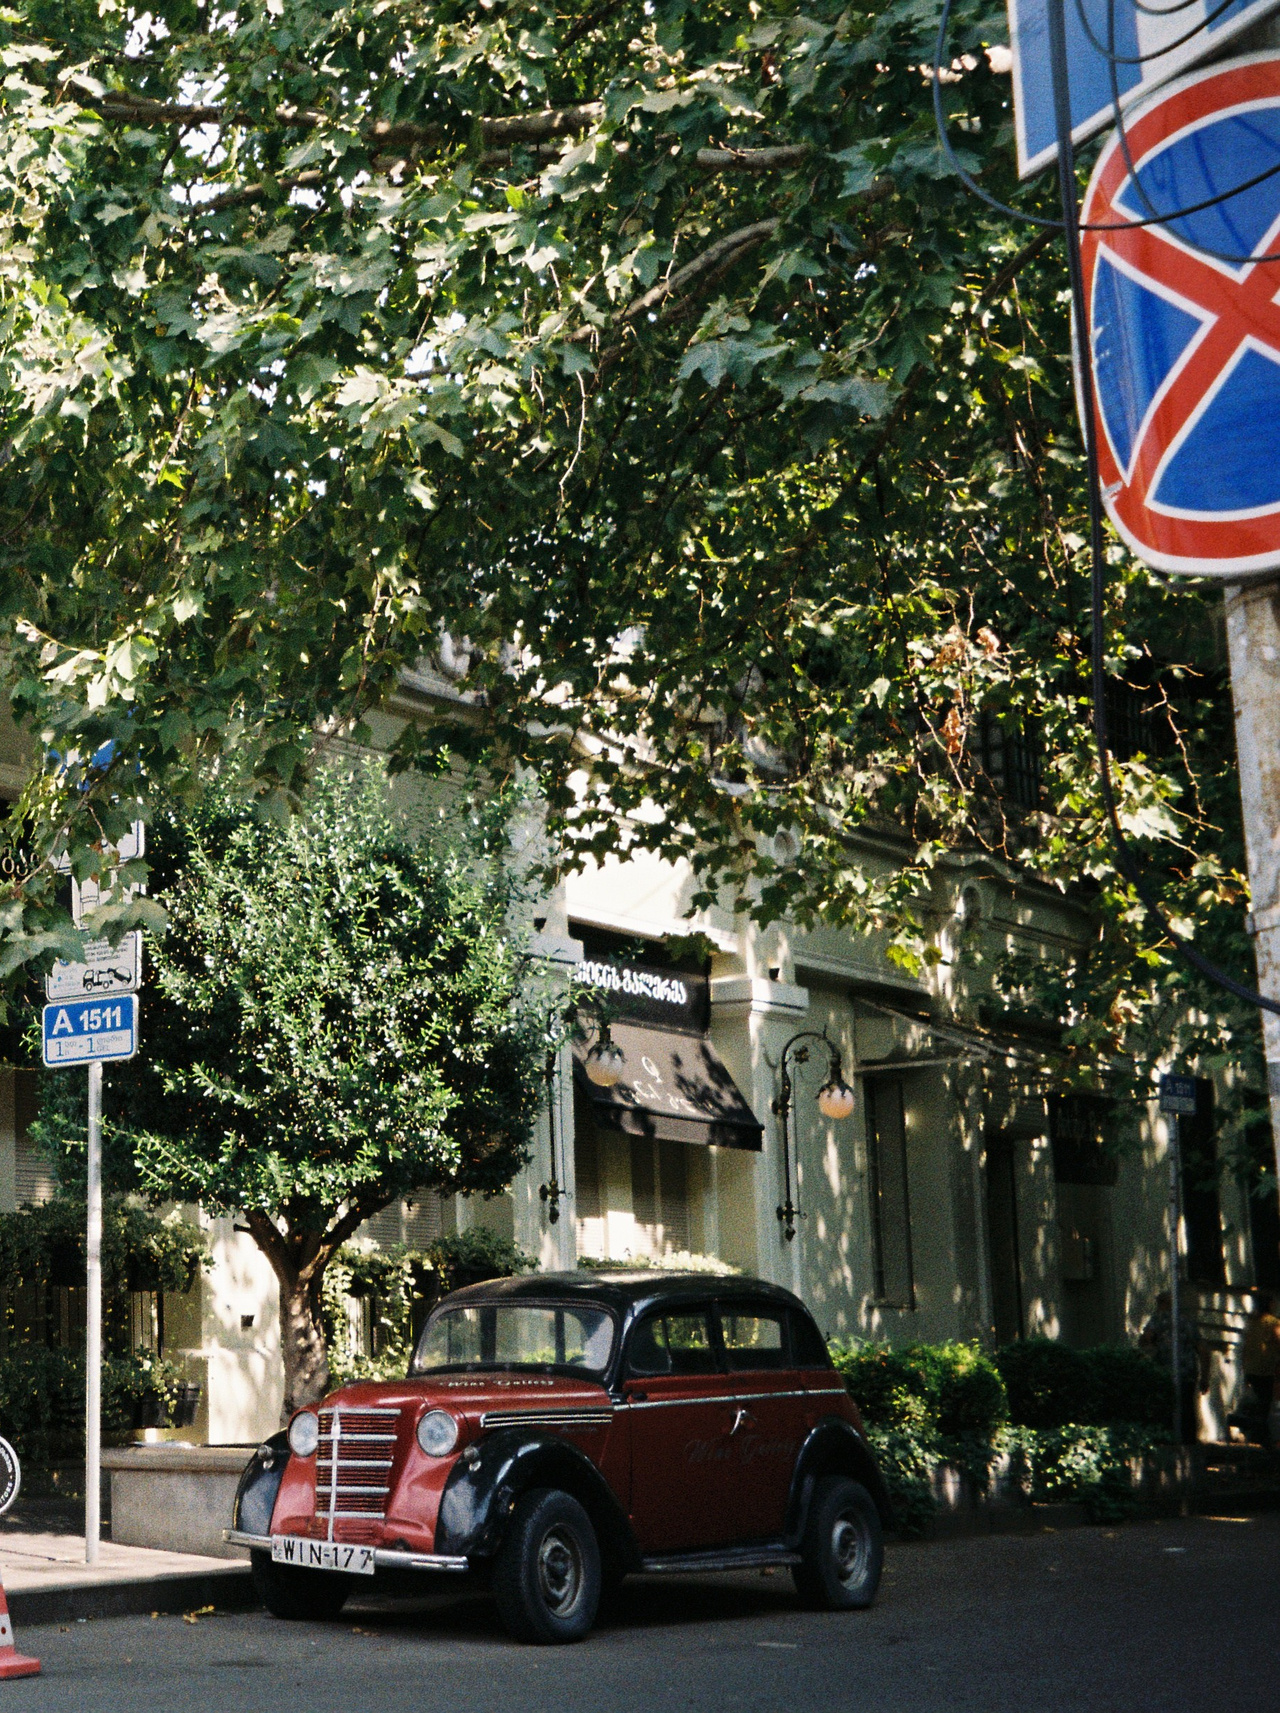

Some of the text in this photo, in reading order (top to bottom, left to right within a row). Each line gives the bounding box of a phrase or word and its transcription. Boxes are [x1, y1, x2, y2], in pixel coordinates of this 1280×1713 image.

[52, 1006, 121, 1035] A 1511
[283, 1538, 372, 1570] WIN-177
